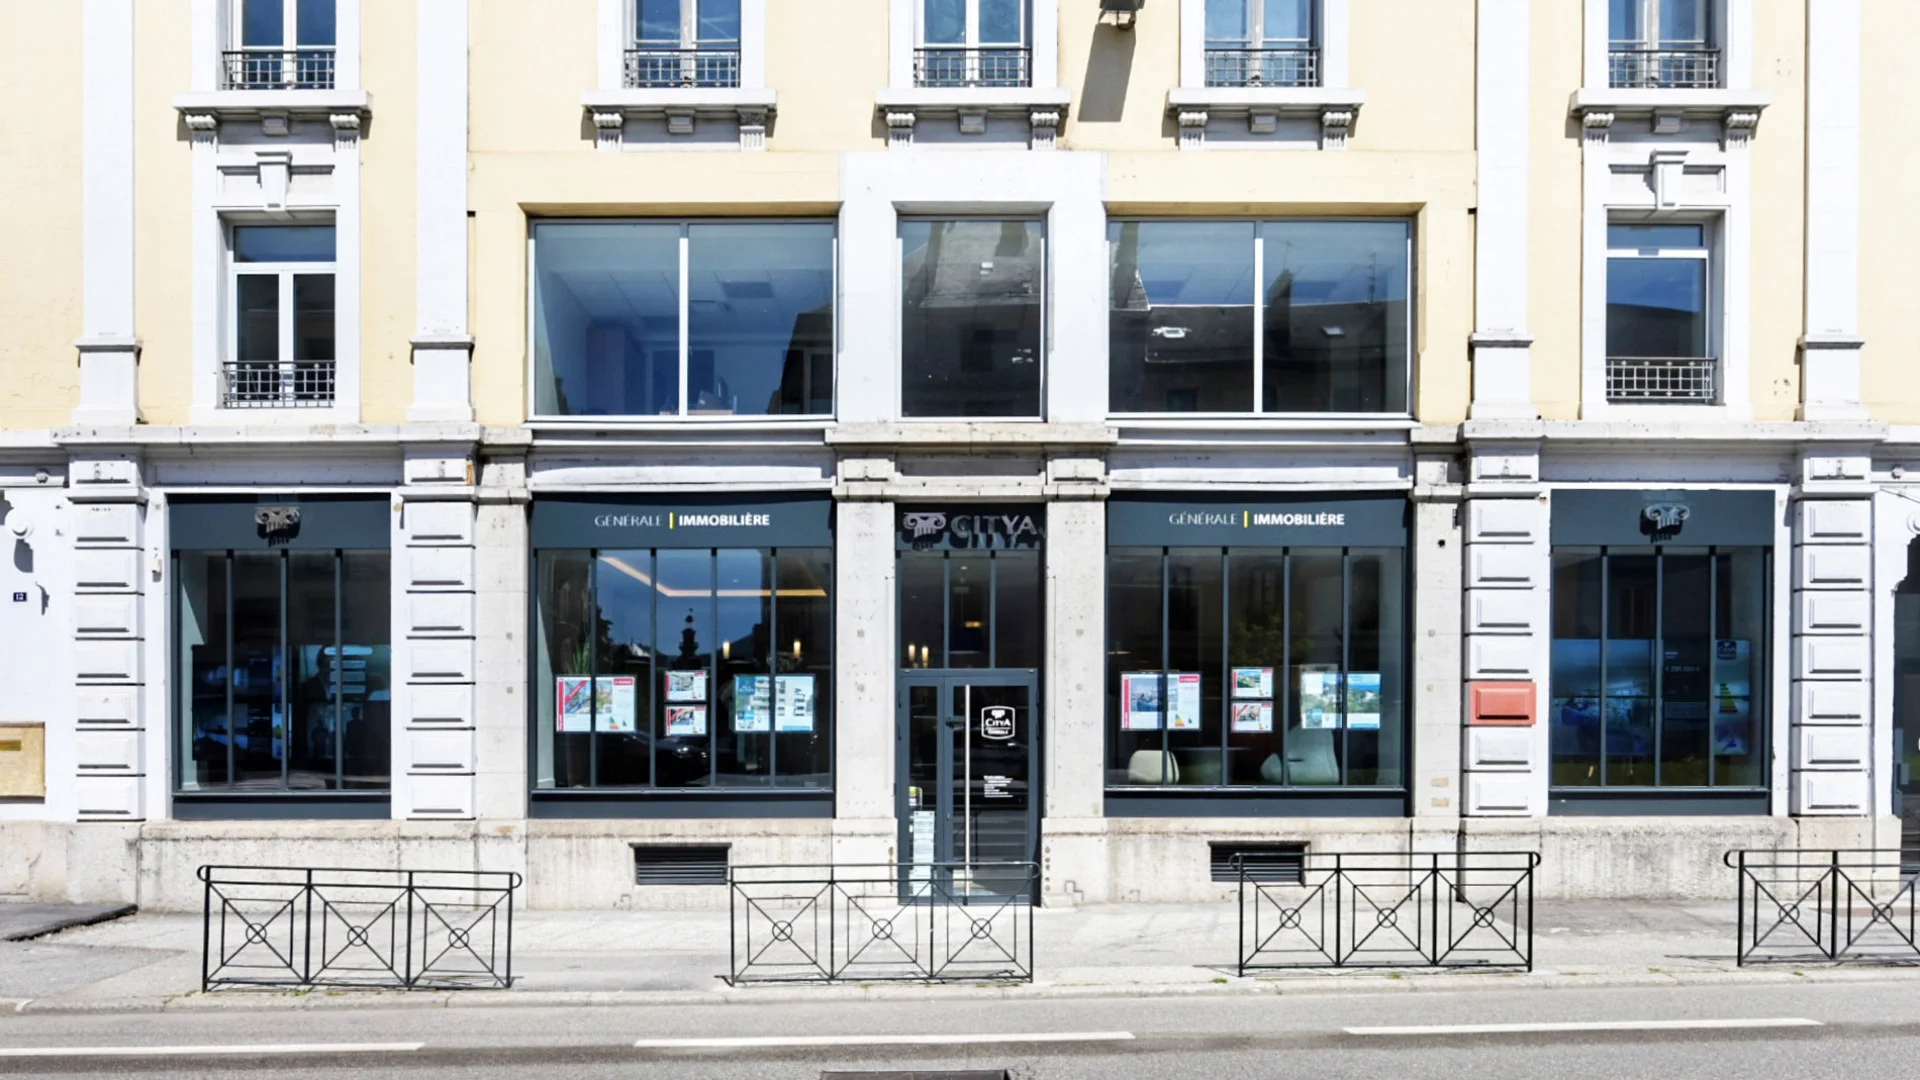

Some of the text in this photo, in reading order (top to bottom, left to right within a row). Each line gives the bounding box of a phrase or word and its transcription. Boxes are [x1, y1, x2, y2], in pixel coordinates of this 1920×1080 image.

[594, 511, 771, 527] GÉNÉRALE IMMOBILIÈRE
[950, 514, 1038, 535] CITYA
[1169, 510, 1346, 526] GÉNÉRALE IMMOBILIÈRE
